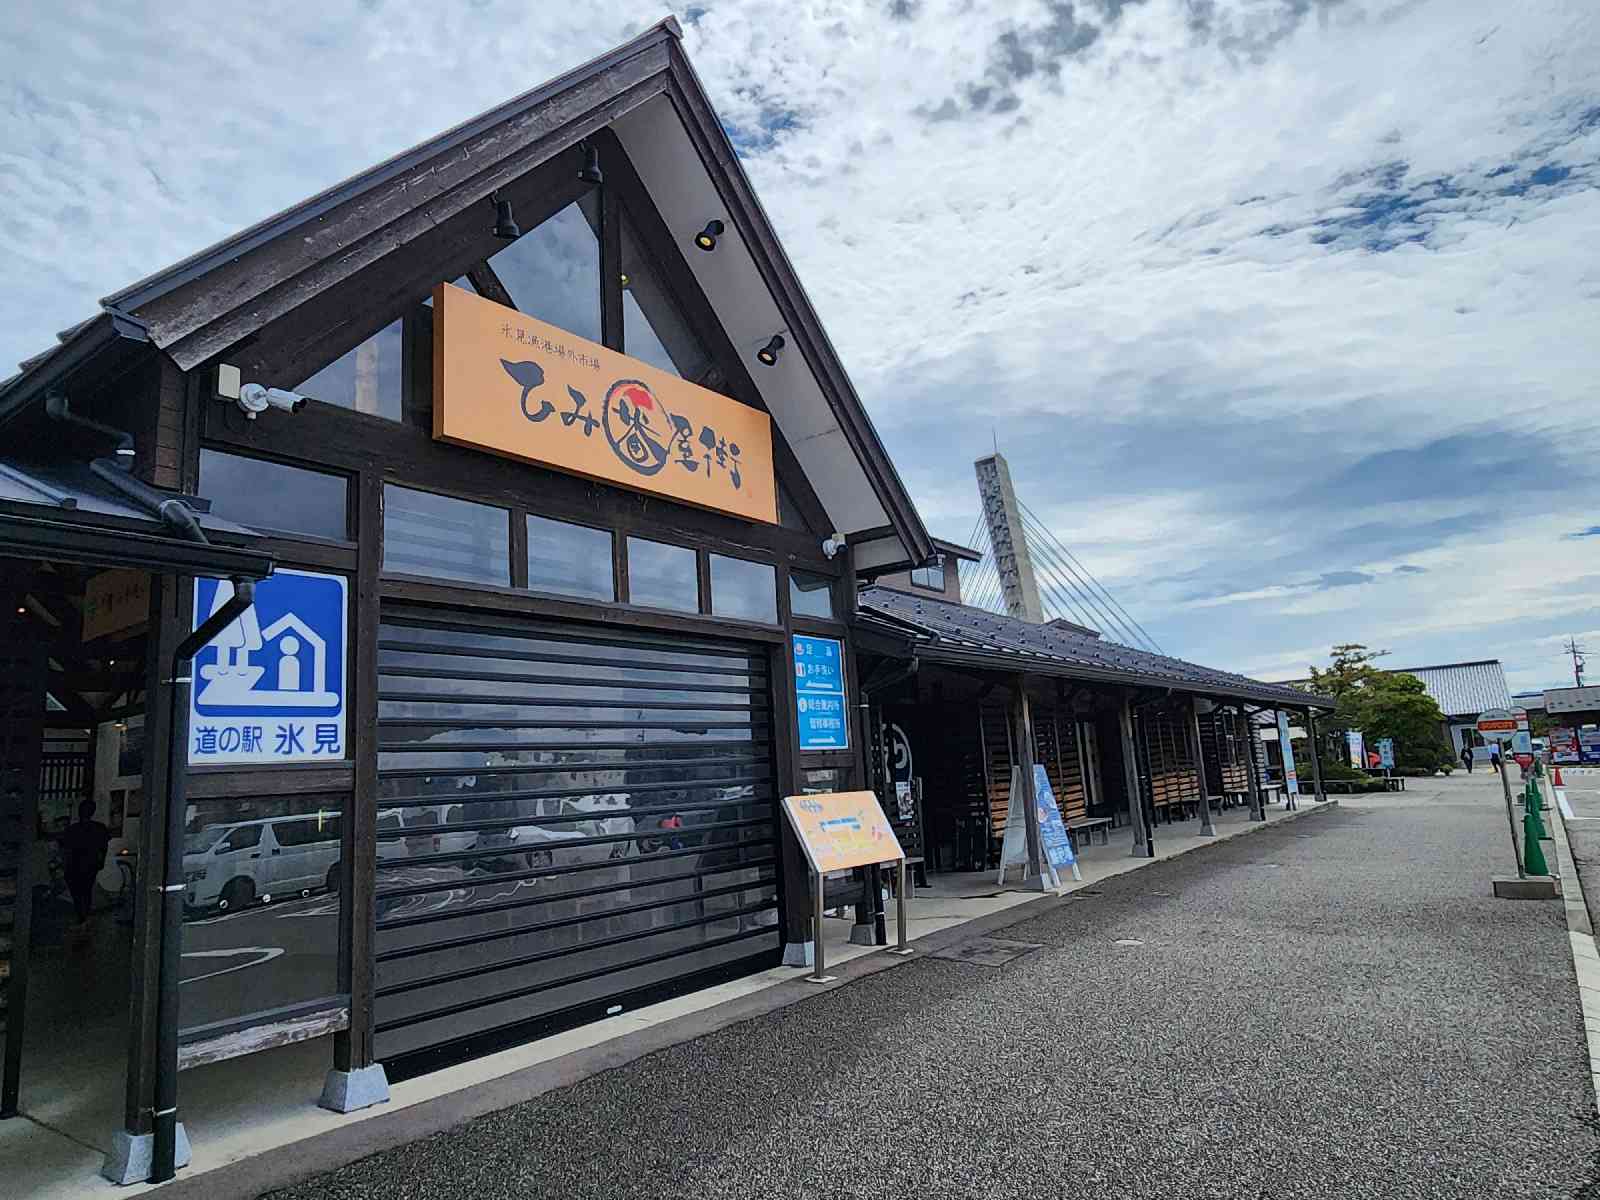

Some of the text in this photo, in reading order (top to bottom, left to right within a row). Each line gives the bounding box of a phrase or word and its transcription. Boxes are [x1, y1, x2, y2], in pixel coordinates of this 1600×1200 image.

[499, 358, 742, 490] ひみ番屋街
[194, 723, 341, 755] 道の駅 氷見
